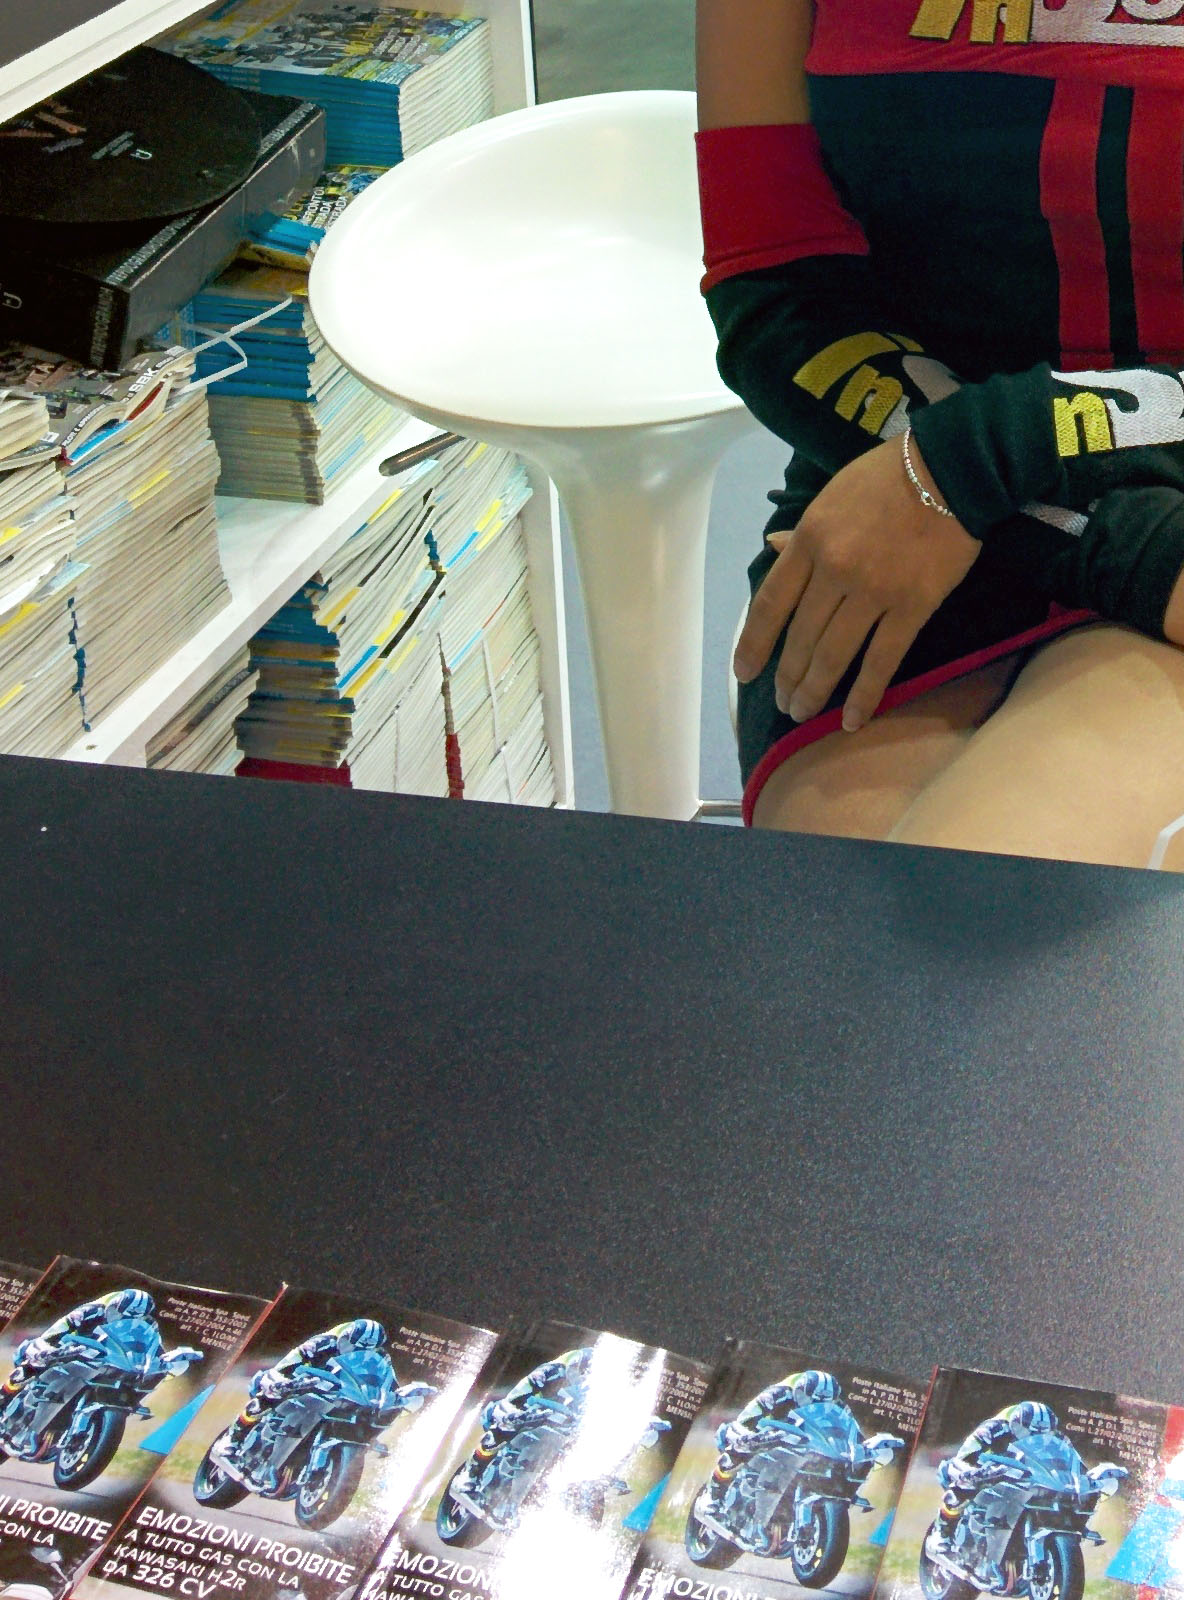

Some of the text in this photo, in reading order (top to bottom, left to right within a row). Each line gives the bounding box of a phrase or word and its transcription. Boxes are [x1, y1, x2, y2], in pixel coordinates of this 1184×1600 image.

[128, 367, 158, 393] SBK
[8, 1498, 112, 1541] PROIBITE
[33, 1532, 54, 1547] LA
[125, 1529, 299, 1589] A TUTTO GAS CON LA
[136, 1505, 254, 1552] EMOZIONI
[251, 1538, 356, 1585] PROIBITE
[102, 1559, 217, 1599] DA 326 CV
[113, 1544, 247, 1592] KAWASAKI H2R
[379, 1549, 494, 1591] EMOZION
[393, 1574, 444, 1596] TUTTO
